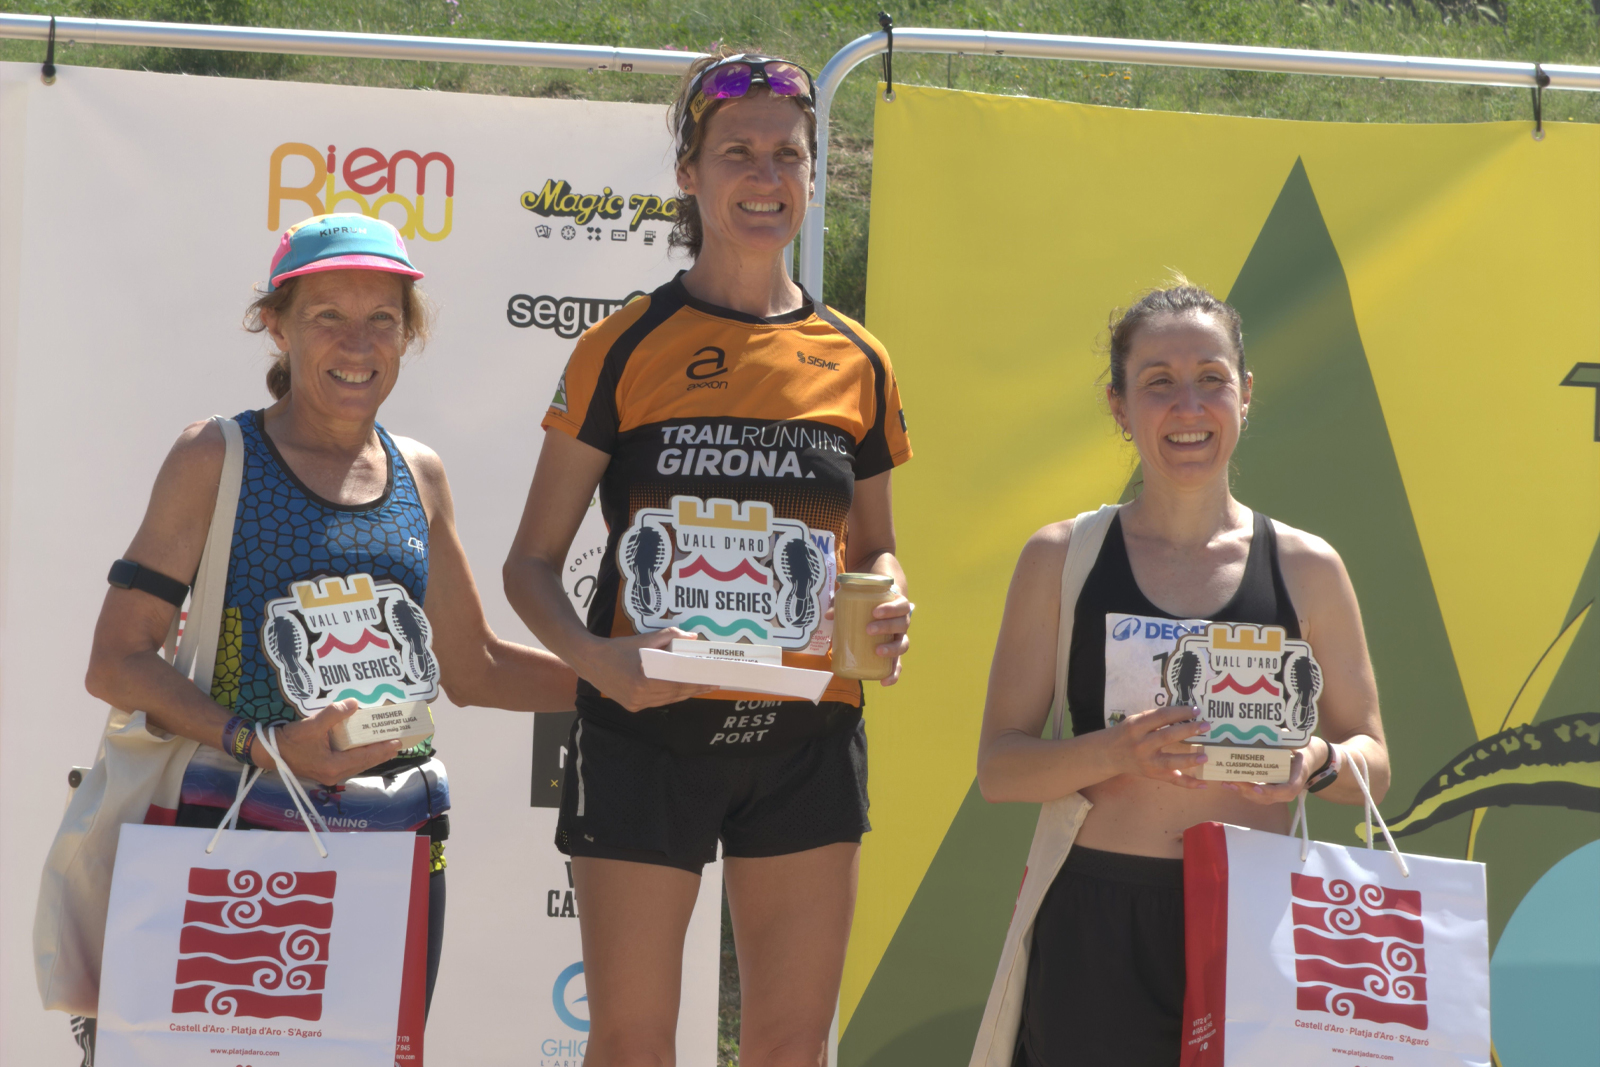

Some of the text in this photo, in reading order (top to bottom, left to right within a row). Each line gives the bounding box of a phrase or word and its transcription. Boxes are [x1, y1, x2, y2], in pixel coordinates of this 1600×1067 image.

[520, 178, 625, 226] Magic
[319, 226, 368, 238] KIPRUN
[807, 355, 841, 372] SISMIC
[686, 381, 728, 391] axxon
[683, 532, 765, 553] VALL D'ARO
[675, 585, 773, 615] RUN SERIES
[309, 607, 378, 628] VALL D'ARO
[708, 647, 746, 658] FINISHER
[319, 655, 401, 686] RUN SERIES
[1215, 655, 1278, 669] VALL D'ARO
[371, 710, 404, 721] FINISHER
[1208, 699, 1282, 721] RUN SERIES
[371, 718, 402, 728] CLASSIFICAT
[402, 716, 418, 724] LLIGA
[723, 712, 777, 729] RESS
[709, 729, 770, 745] PORT
[1230, 753, 1265, 761] FINISHER
[284, 808, 368, 829] GIRAINING
[547, 889, 579, 918] CA
[169, 1022, 323, 1039] Castell d'Aro Platja d'Aro S'Agaró
[1294, 1019, 1430, 1047] Castell d'Aro Platja d'Aro S'Agaró
[210, 1047, 280, 1057] www.platjadaro.com
[1331, 1047, 1395, 1061] www.platjadaro.com
